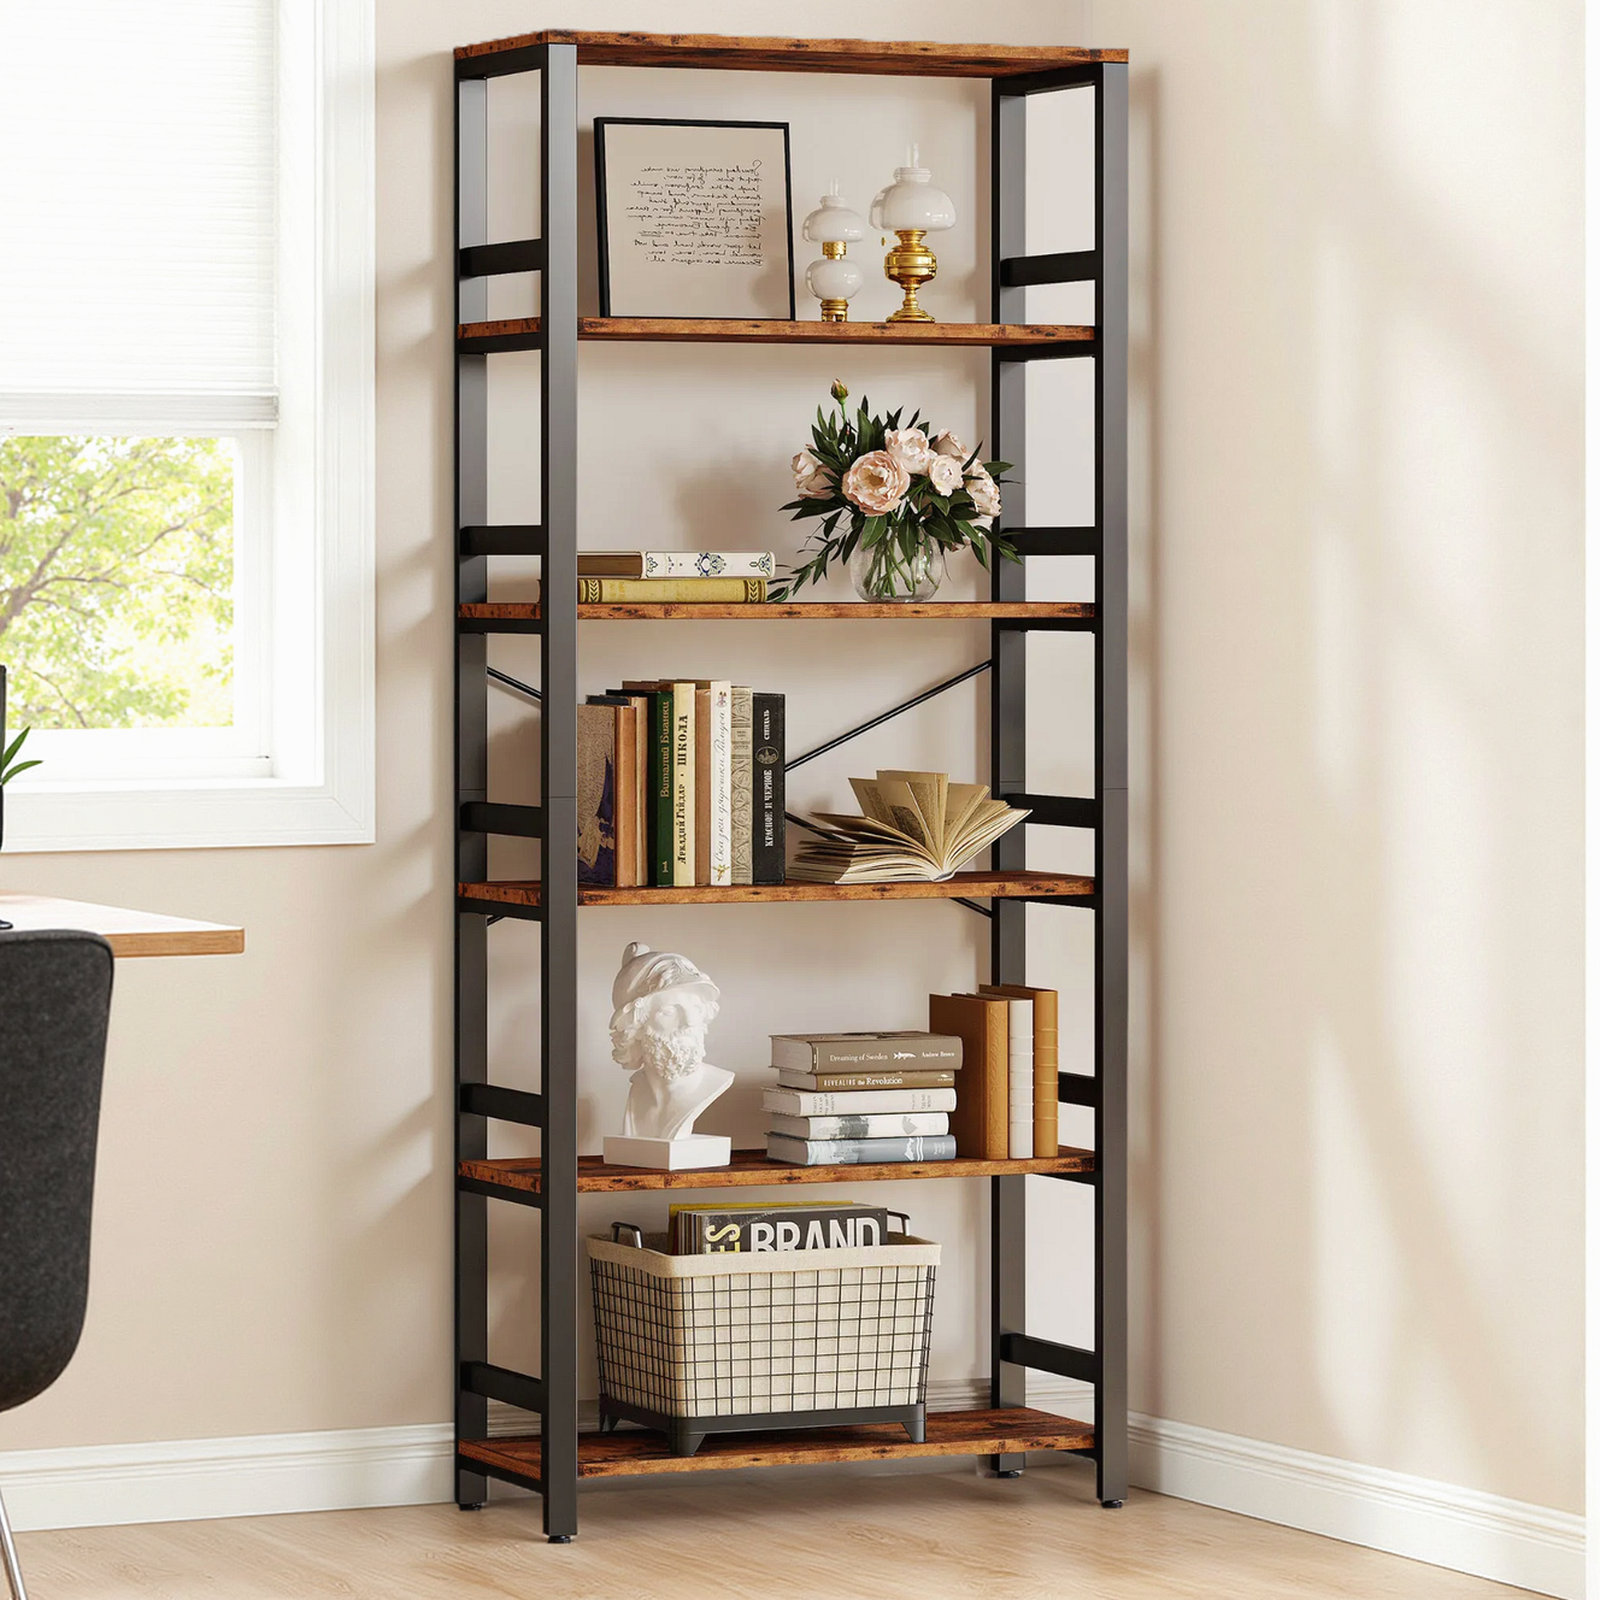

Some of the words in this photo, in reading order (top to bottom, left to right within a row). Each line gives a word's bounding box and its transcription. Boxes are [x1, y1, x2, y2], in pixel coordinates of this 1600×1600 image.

[660, 701, 669, 744] Бианки
[676, 714, 688, 766] ШКОЛА
[659, 747, 669, 798] Виталий
[764, 769, 773, 801] ЧЕРНОЕ
[764, 811, 773, 847] КРАСНОЕ
[829, 1054, 858, 1063] Dreaming
[866, 1076, 903, 1085] Revolution
[750, 1217, 881, 1253] BRAND
